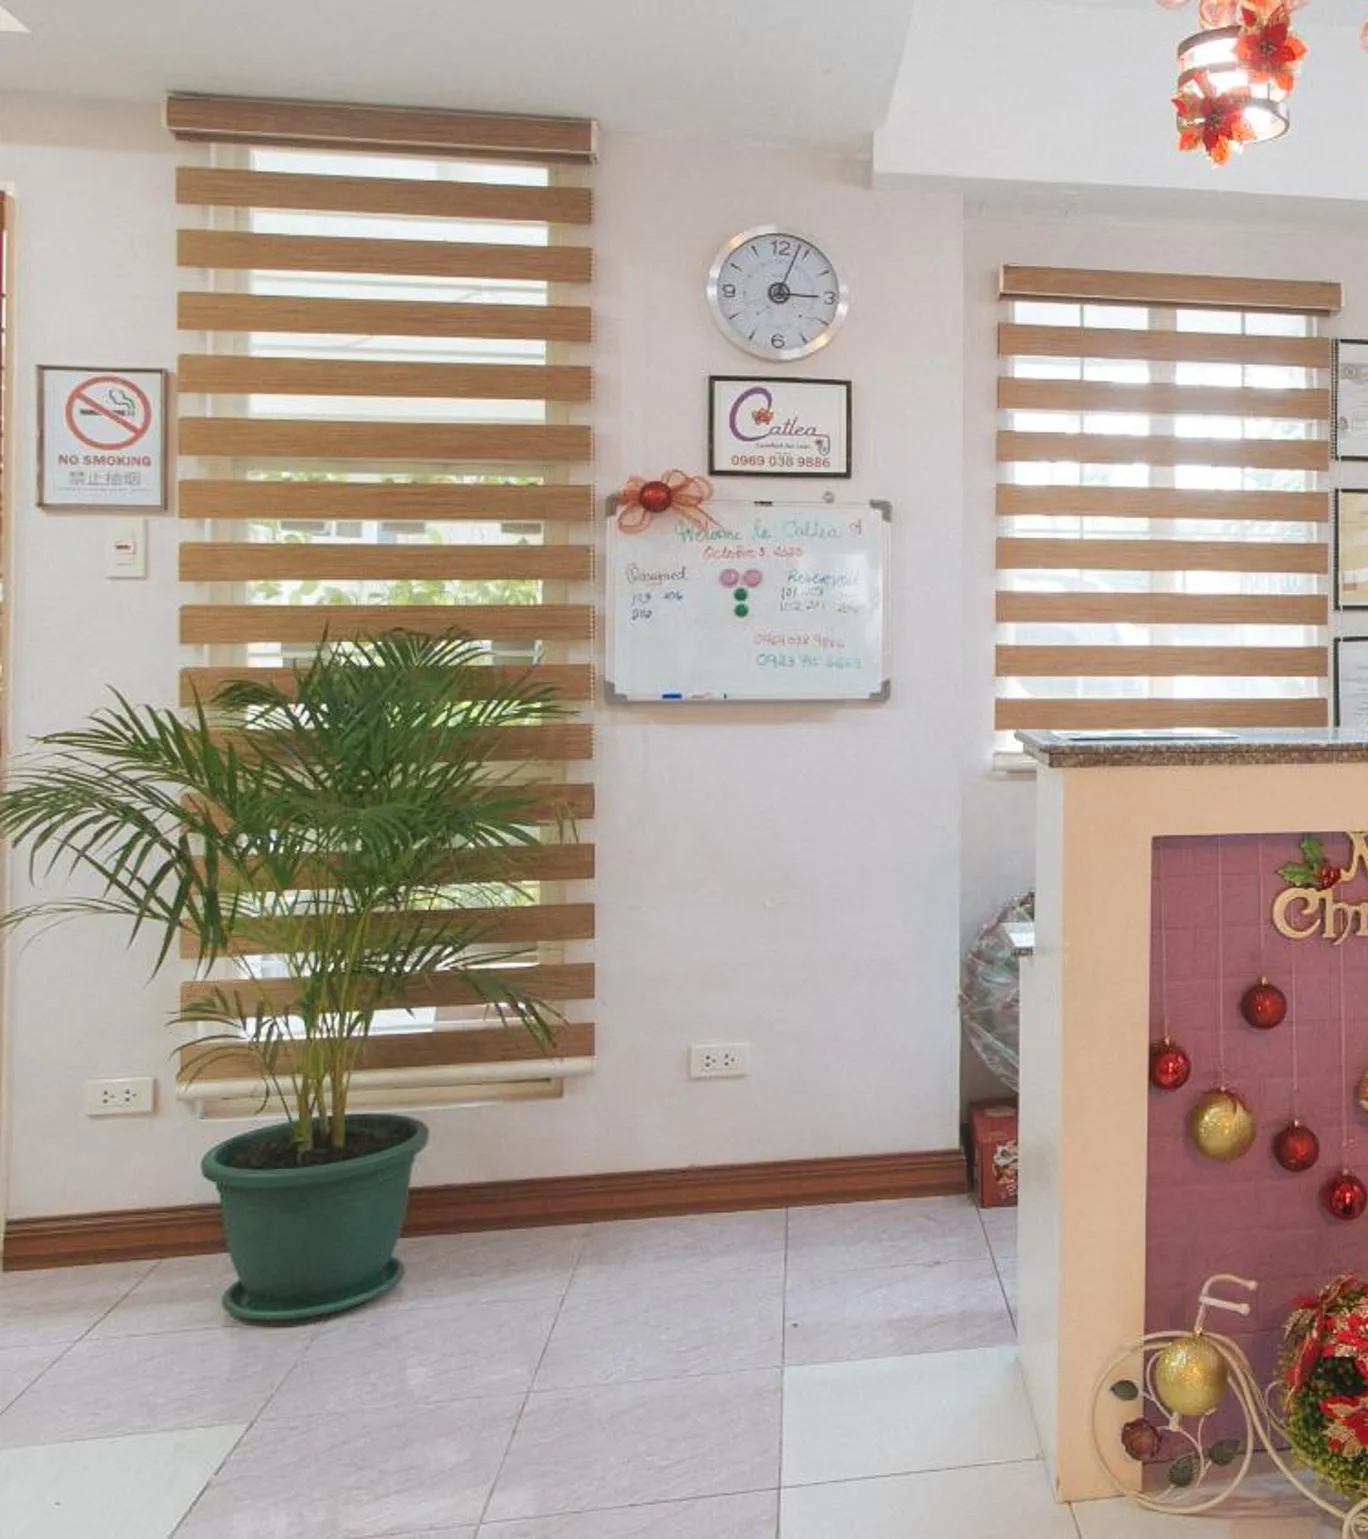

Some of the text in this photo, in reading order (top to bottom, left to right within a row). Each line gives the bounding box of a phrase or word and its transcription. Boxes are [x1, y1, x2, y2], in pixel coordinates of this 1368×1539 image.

[771, 240, 791, 256] 12
[722, 283, 737, 298] 9
[823, 291, 836, 305] 3
[771, 333, 785, 349] 6
[729, 386, 818, 442] Catlea
[58, 454, 152, 468] NO SMOKING
[731, 454, 766, 467] 0969
[797, 456, 831, 468] 9886
